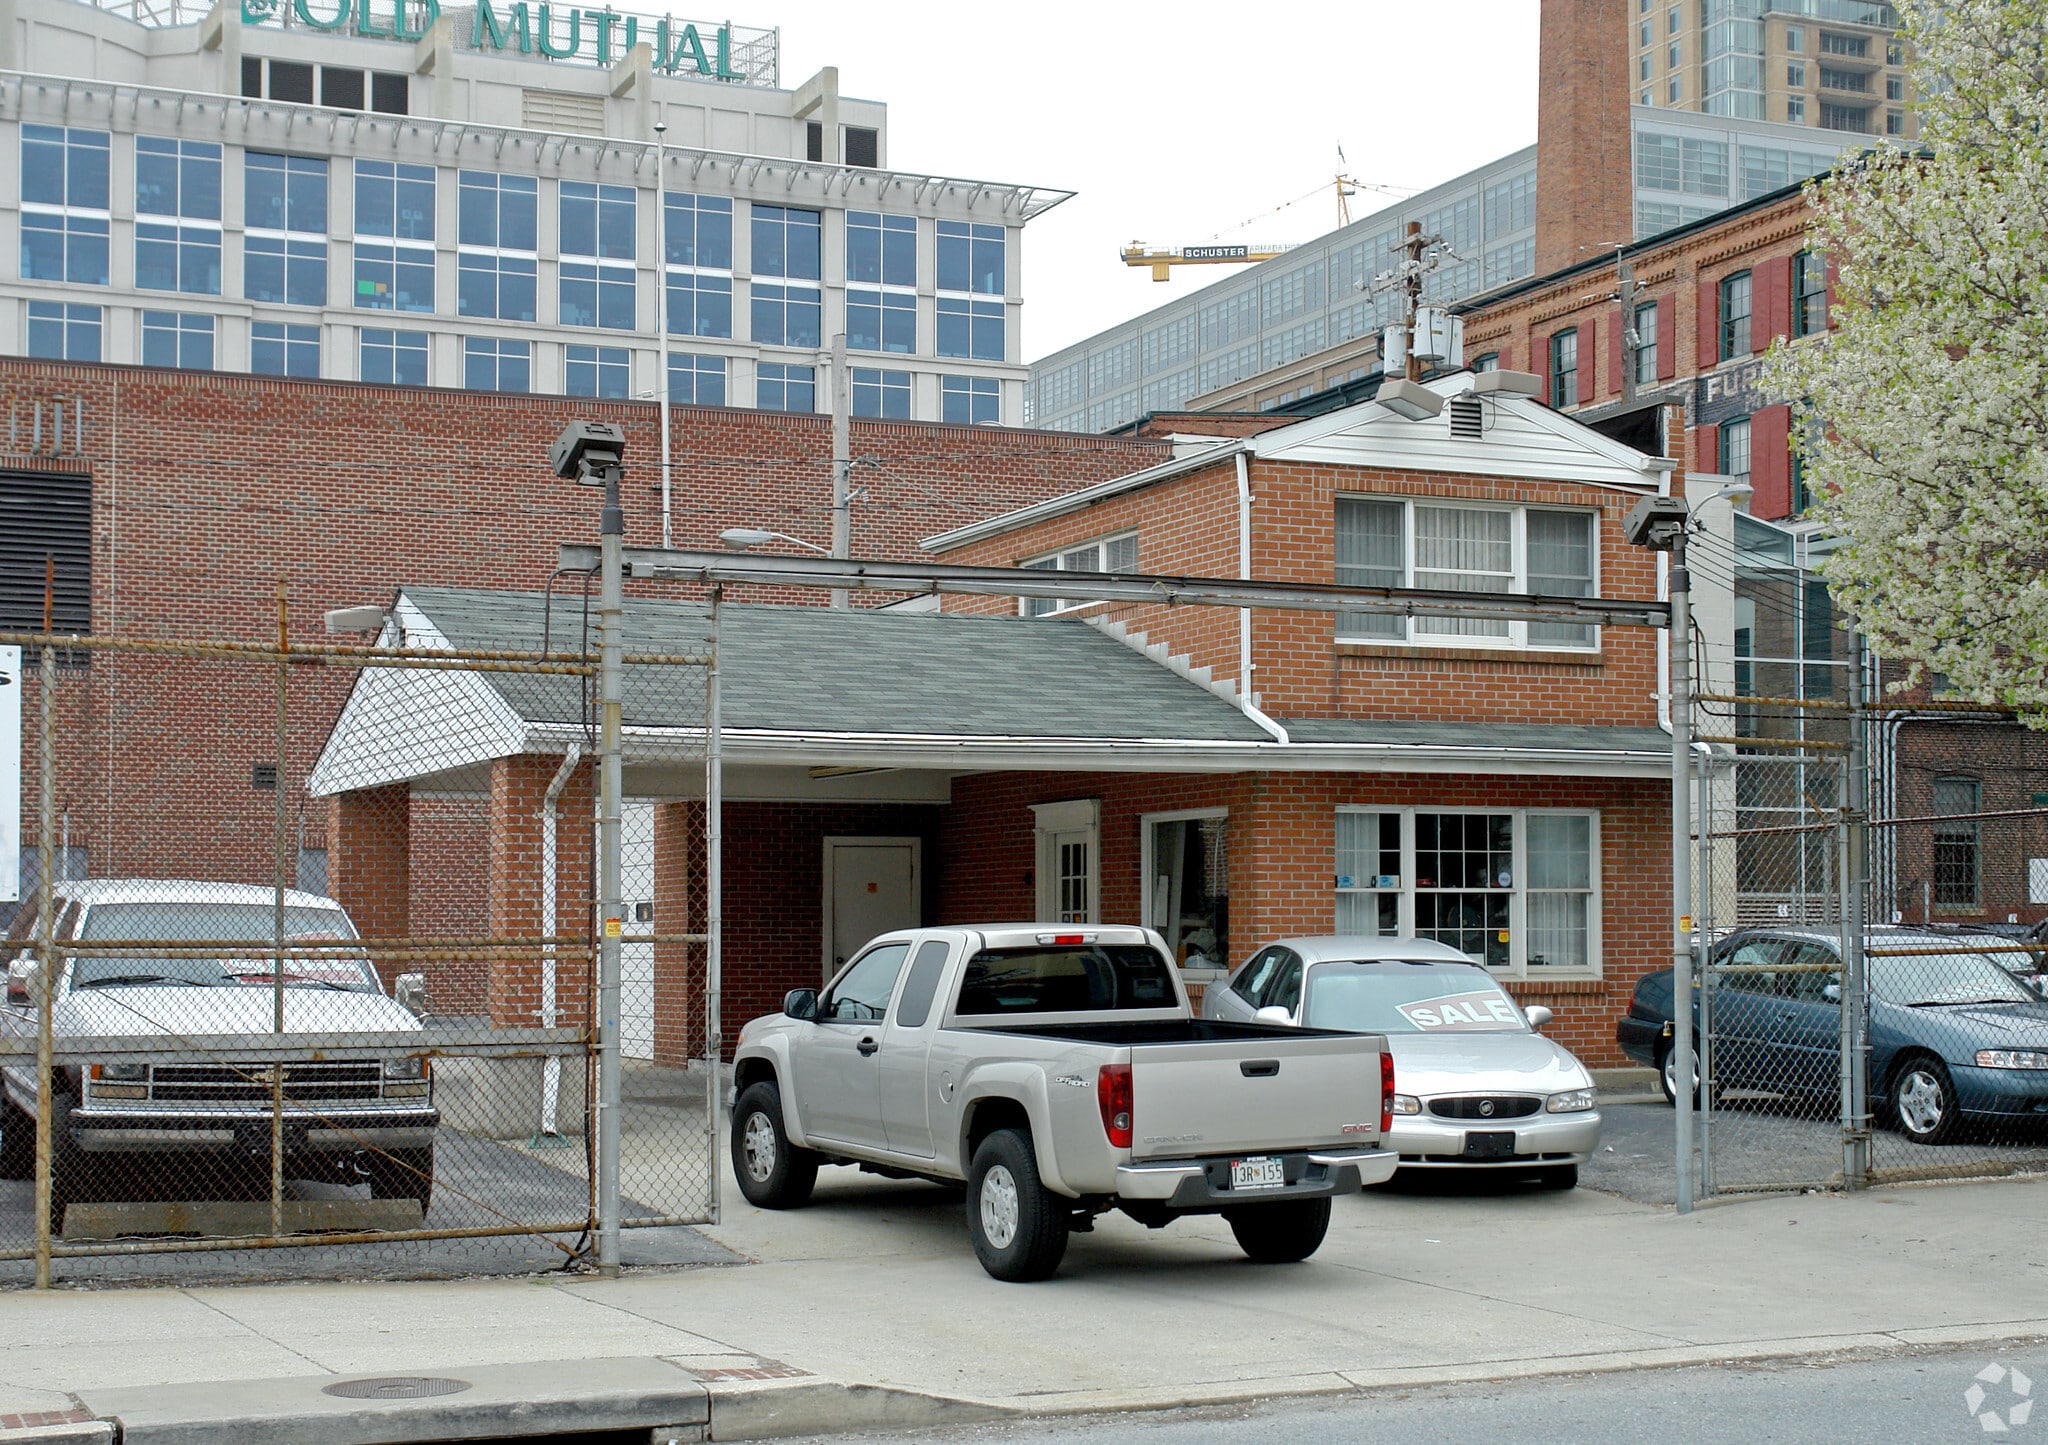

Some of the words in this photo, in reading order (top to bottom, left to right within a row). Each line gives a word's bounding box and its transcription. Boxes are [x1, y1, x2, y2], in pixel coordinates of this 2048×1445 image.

[294, 0, 441, 39] OLD
[472, 0, 747, 80] MUTUAL
[1185, 247, 1245, 258] SCHUSTER
[1410, 1000, 1519, 1026] SALE
[1341, 1123, 1373, 1134] GMC
[1262, 1163, 1283, 1181] 155
